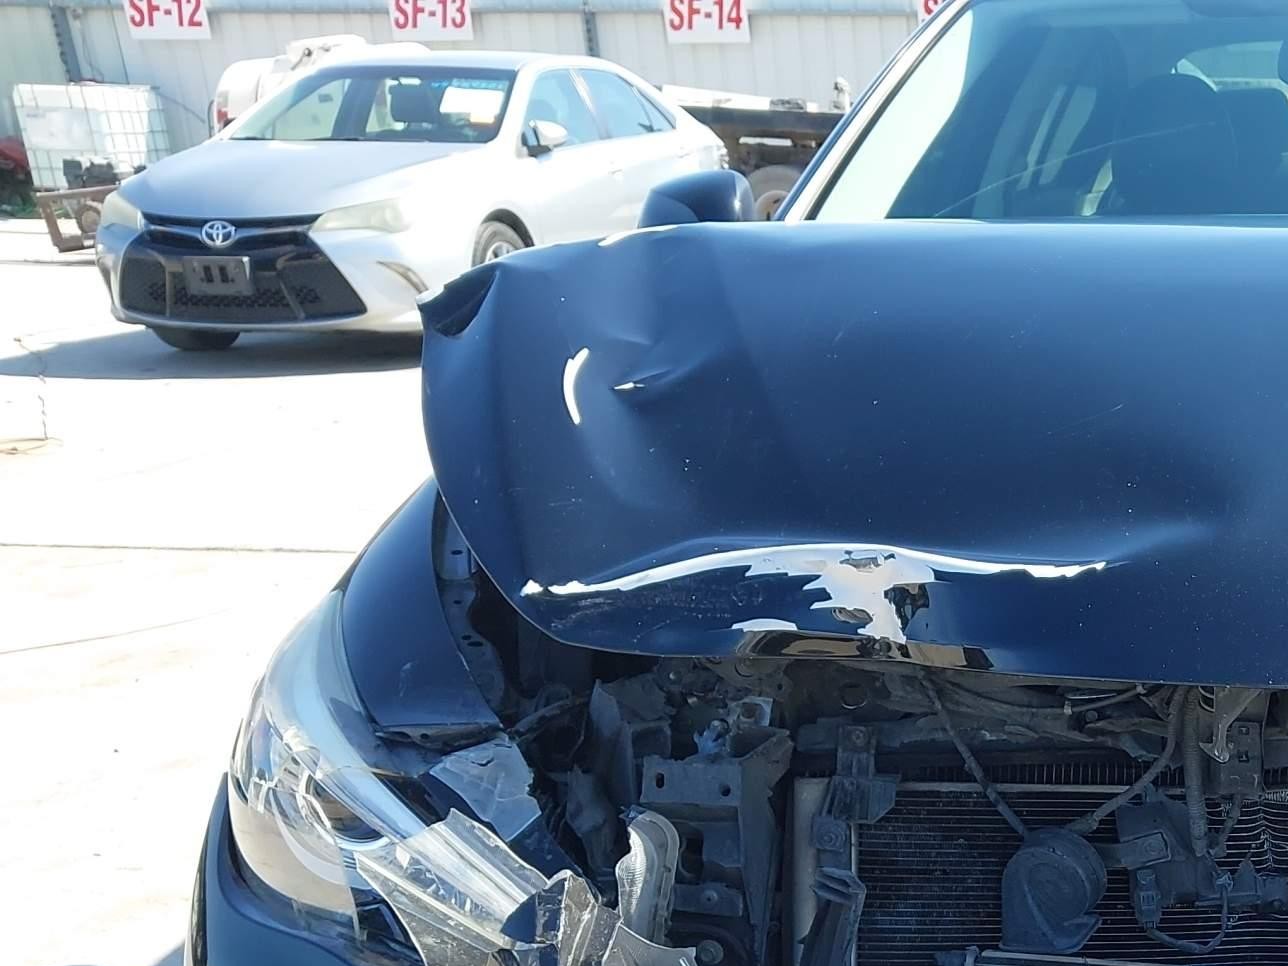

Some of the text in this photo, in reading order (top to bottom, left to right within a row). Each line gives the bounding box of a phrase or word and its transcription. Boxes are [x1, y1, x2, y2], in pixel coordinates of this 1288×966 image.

[129, 0, 202, 28] SF-12
[394, 0, 466, 29] SF-13
[669, 0, 743, 31] SF-14
